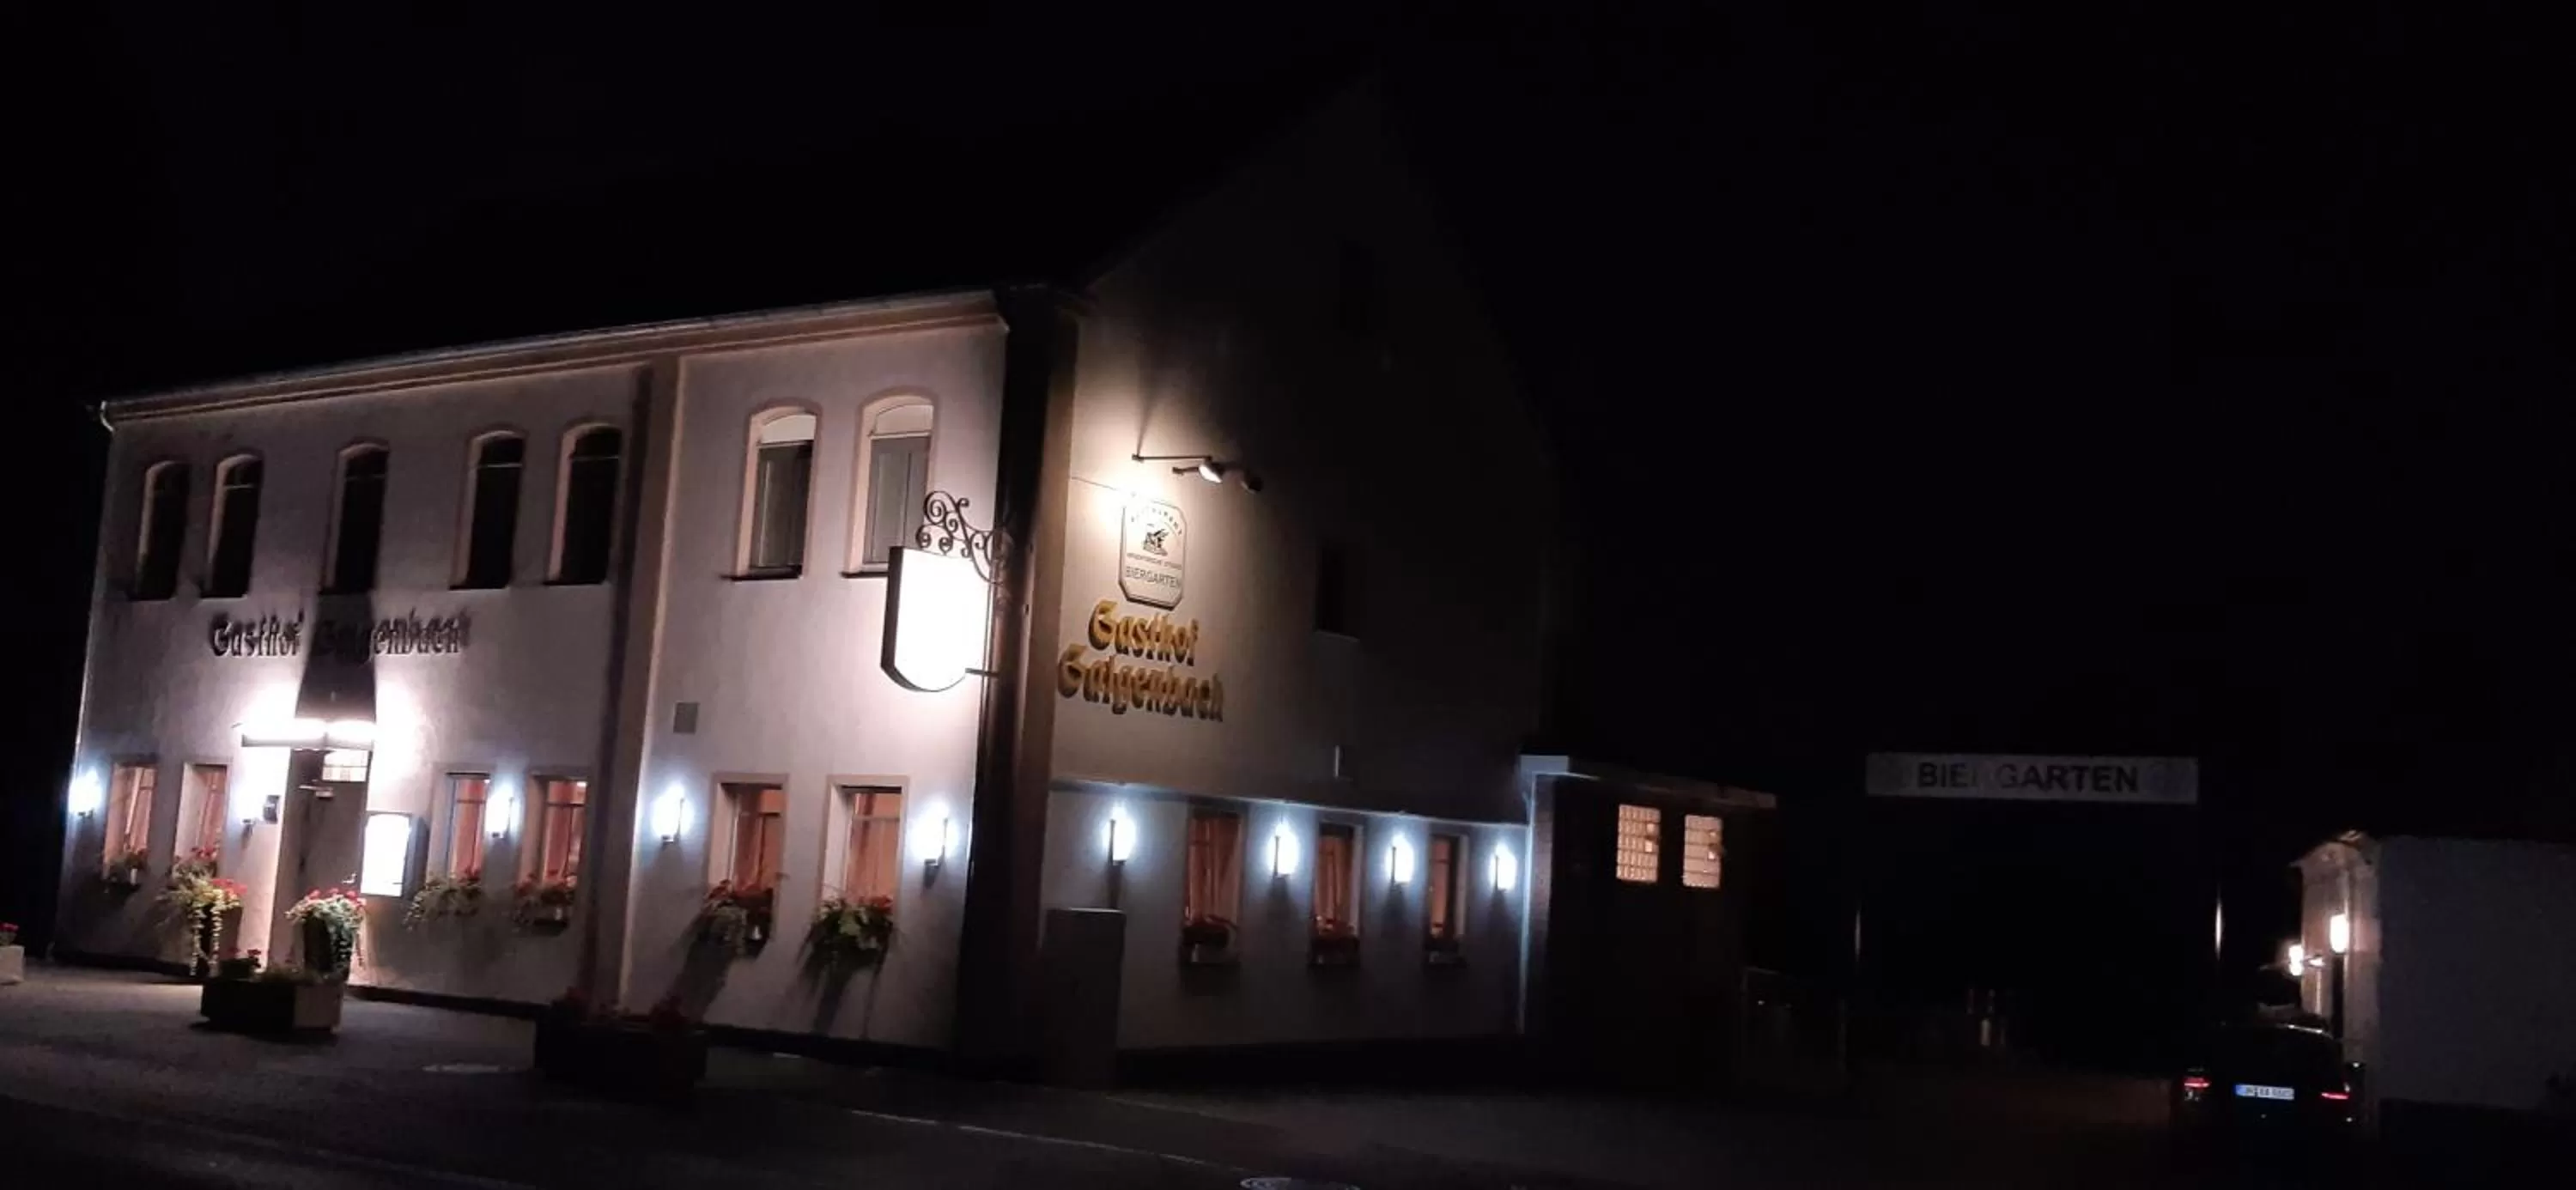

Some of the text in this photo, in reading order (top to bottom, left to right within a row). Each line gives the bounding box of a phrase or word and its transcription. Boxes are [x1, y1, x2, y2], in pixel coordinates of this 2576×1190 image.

[210, 608, 305, 657] Gasthof
[1089, 600, 1199, 666] Gasthof
[1917, 761, 2140, 792] BIEGARTEN
